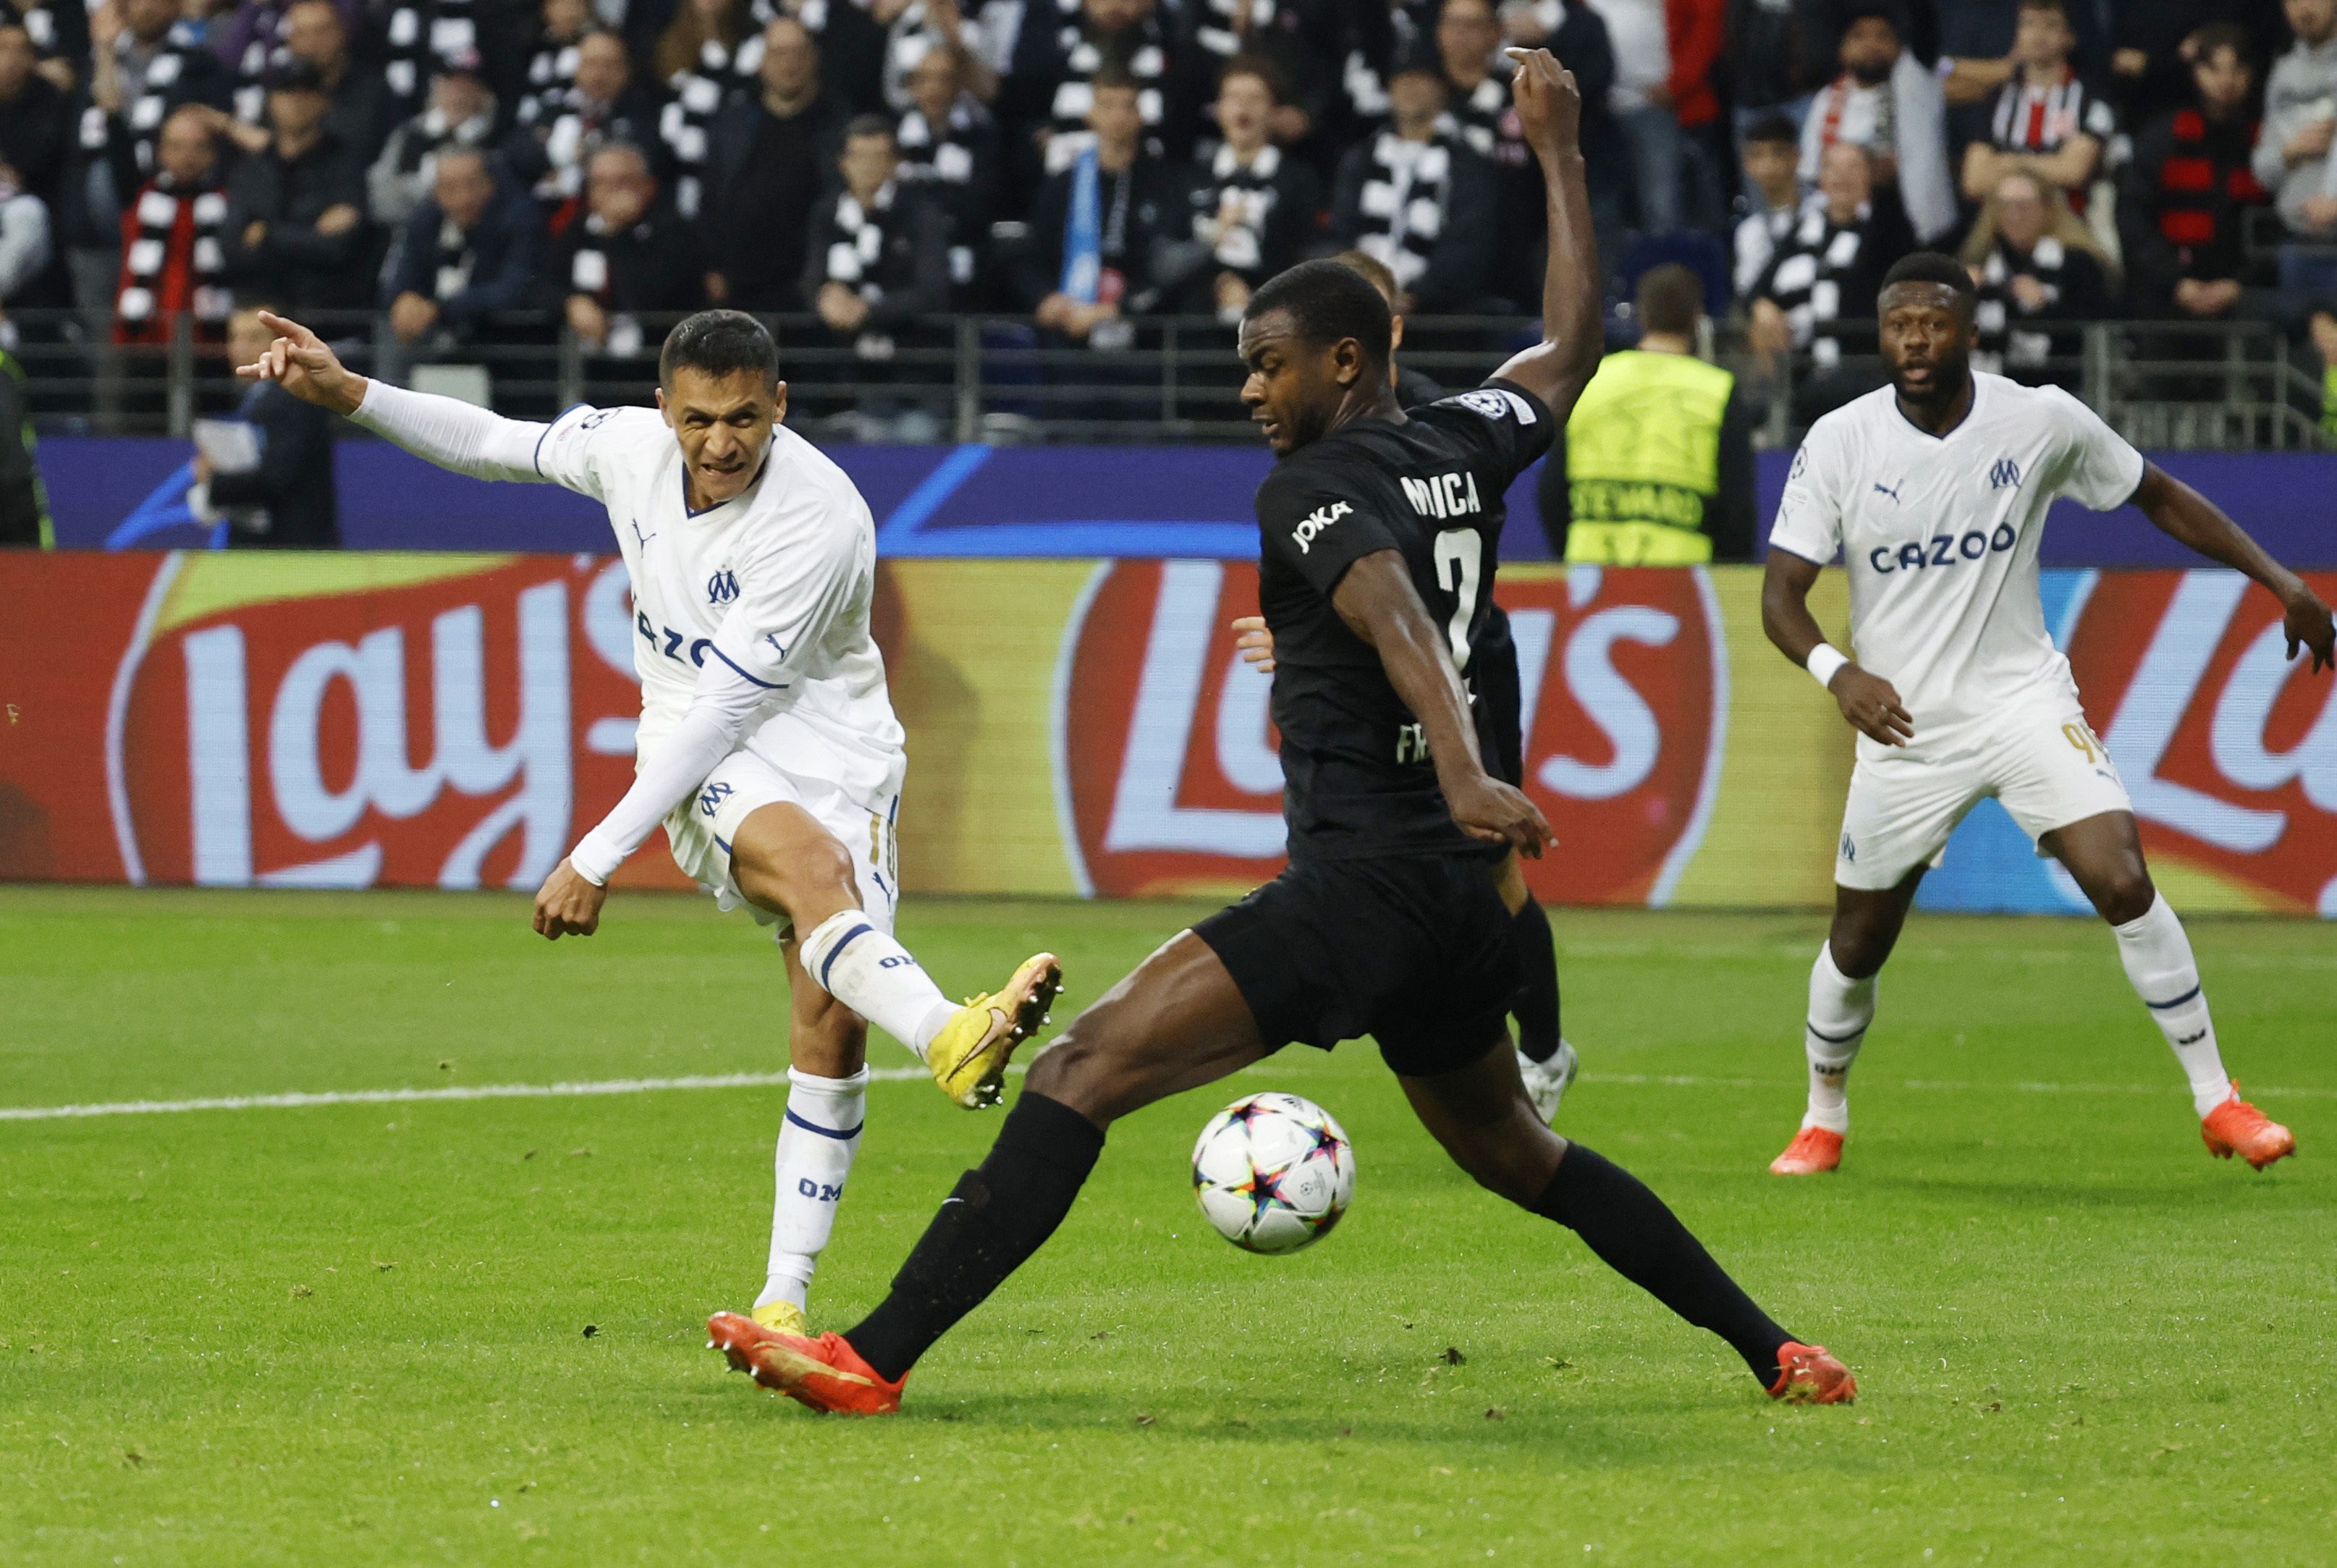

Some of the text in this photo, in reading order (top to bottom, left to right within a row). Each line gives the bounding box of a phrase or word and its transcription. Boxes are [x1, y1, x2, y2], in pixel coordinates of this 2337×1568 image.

[1291, 501, 1354, 555] JOKA
[1870, 522, 2016, 573] CAZOO
[1396, 723, 1427, 764] FR
[798, 1178, 844, 1201] OM
